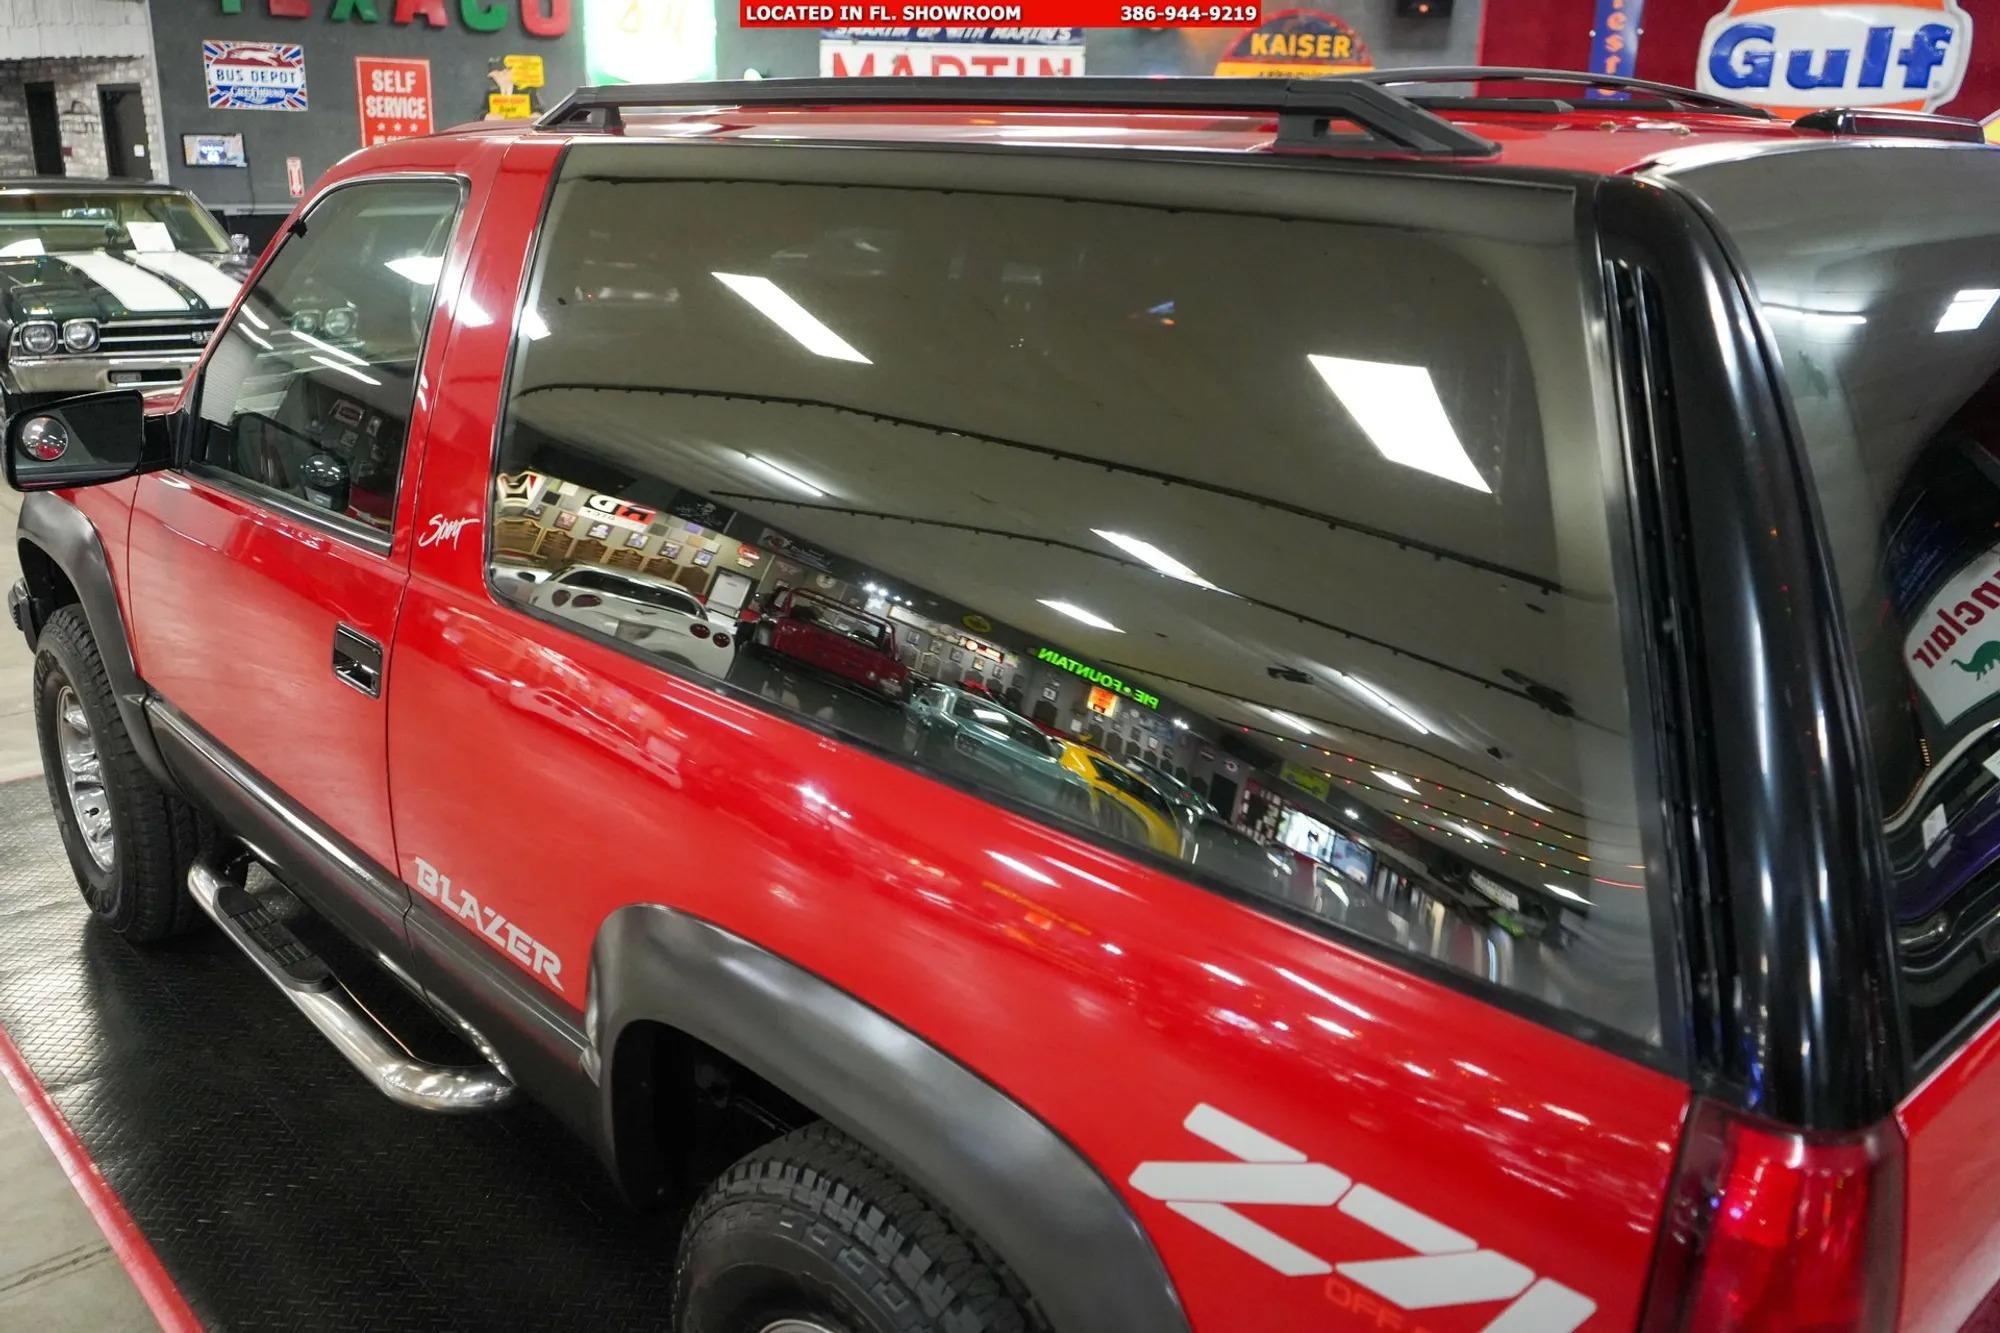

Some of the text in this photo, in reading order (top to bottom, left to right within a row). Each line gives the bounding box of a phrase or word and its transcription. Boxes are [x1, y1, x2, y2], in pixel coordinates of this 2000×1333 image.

[1250, 32, 1351, 58] KAISER
[1708, 23, 1953, 90] Gulf
[216, 69, 296, 83] BUS DEPOT
[371, 68, 416, 94] SELF
[365, 94, 427, 120] SERVICE
[418, 513, 480, 551] Sport
[415, 856, 565, 992] BLAZER
